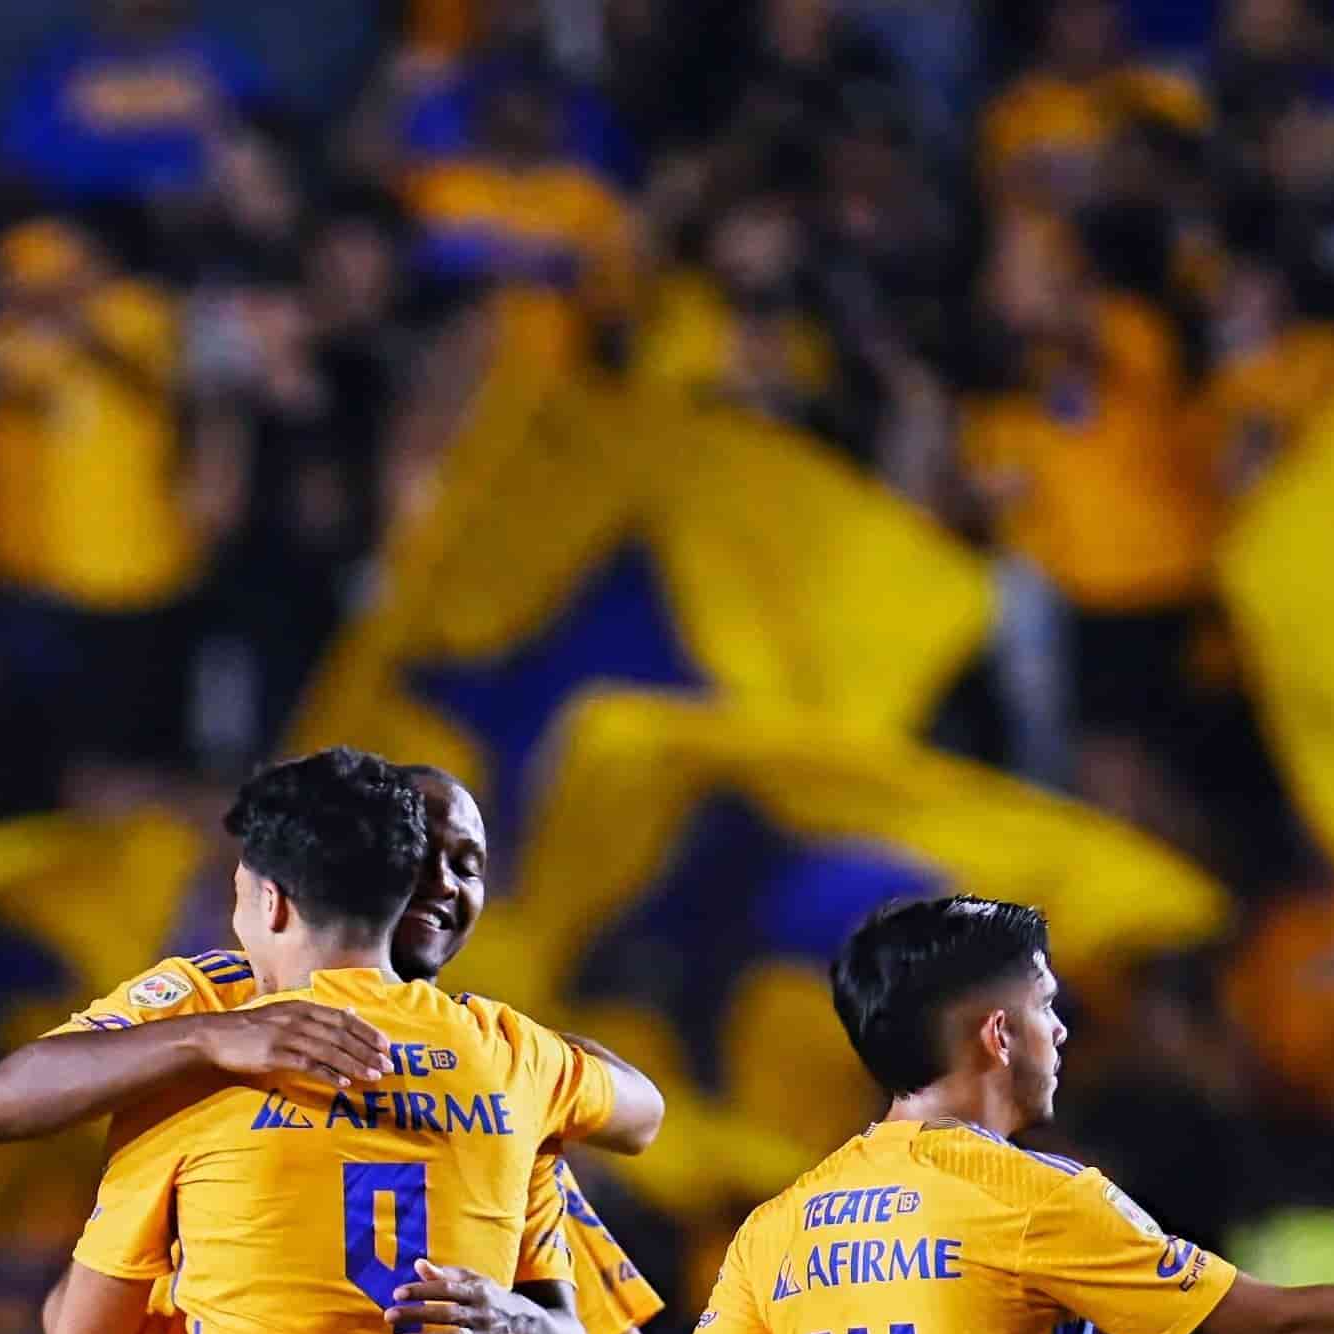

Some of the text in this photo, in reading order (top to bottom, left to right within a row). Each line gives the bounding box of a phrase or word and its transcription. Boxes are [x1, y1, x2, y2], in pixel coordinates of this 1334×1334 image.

[327, 1090, 514, 1135] AFIRME
[803, 1185, 900, 1230] TECATE
[806, 1239, 962, 1290] AFIRME
